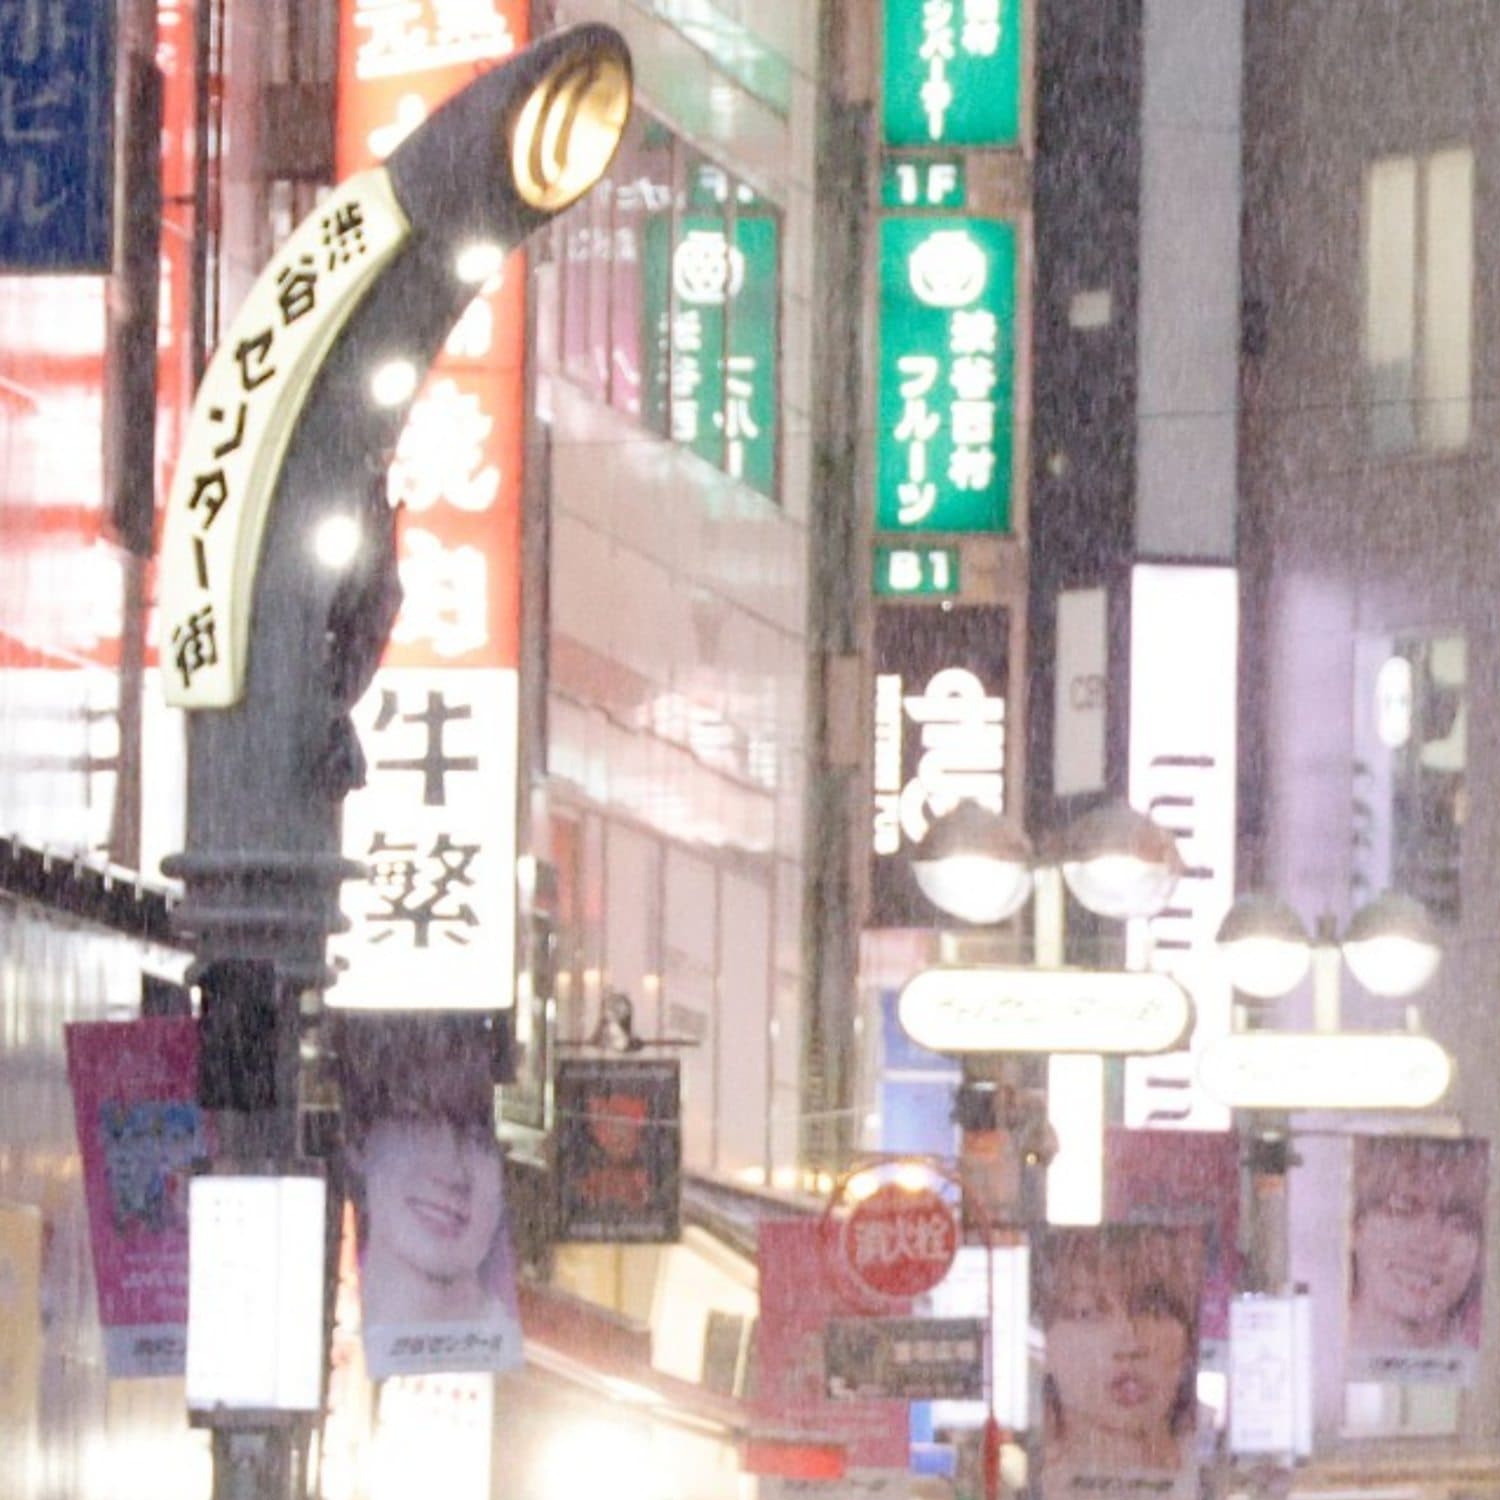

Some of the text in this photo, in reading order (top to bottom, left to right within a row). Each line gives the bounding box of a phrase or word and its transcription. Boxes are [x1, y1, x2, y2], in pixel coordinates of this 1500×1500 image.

[897, 164, 957, 204] 1F
[172, 200, 367, 687] 渋谷センター街
[893, 356, 941, 525] フルーツ
[889, 550, 949, 590] B1
[364, 689, 481, 948] 牛繁
